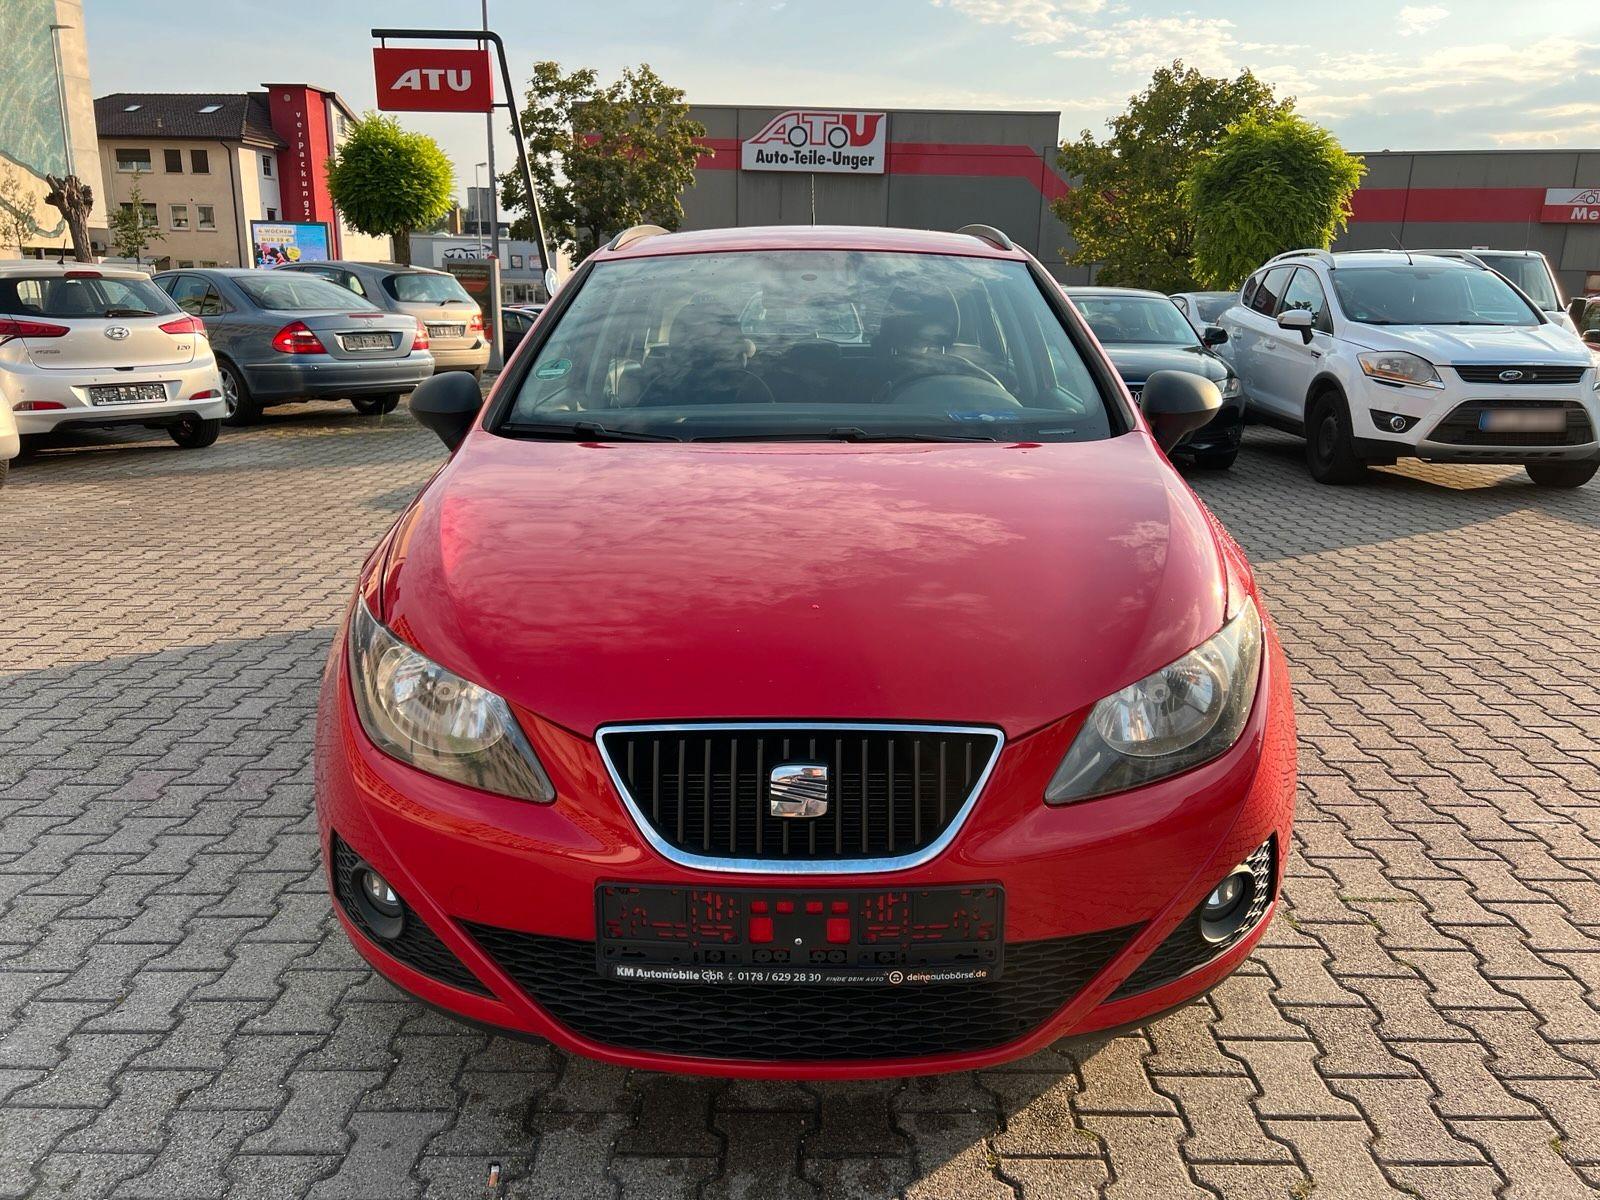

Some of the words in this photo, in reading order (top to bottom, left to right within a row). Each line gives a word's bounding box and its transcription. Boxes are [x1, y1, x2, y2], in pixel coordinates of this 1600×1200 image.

[390, 68, 472, 92] ATU
[755, 149, 875, 170] Auto-Teile-Unger
[616, 966, 634, 977] KM
[636, 967, 700, 980] Automobile
[701, 970, 724, 981] GbR
[737, 971, 764, 982] 0178
[765, 972, 770, 982] /
[771, 972, 791, 982] 629
[793, 972, 806, 982] 28
[808, 972, 822, 982] 30
[906, 970, 987, 982] deineautobörse.de
